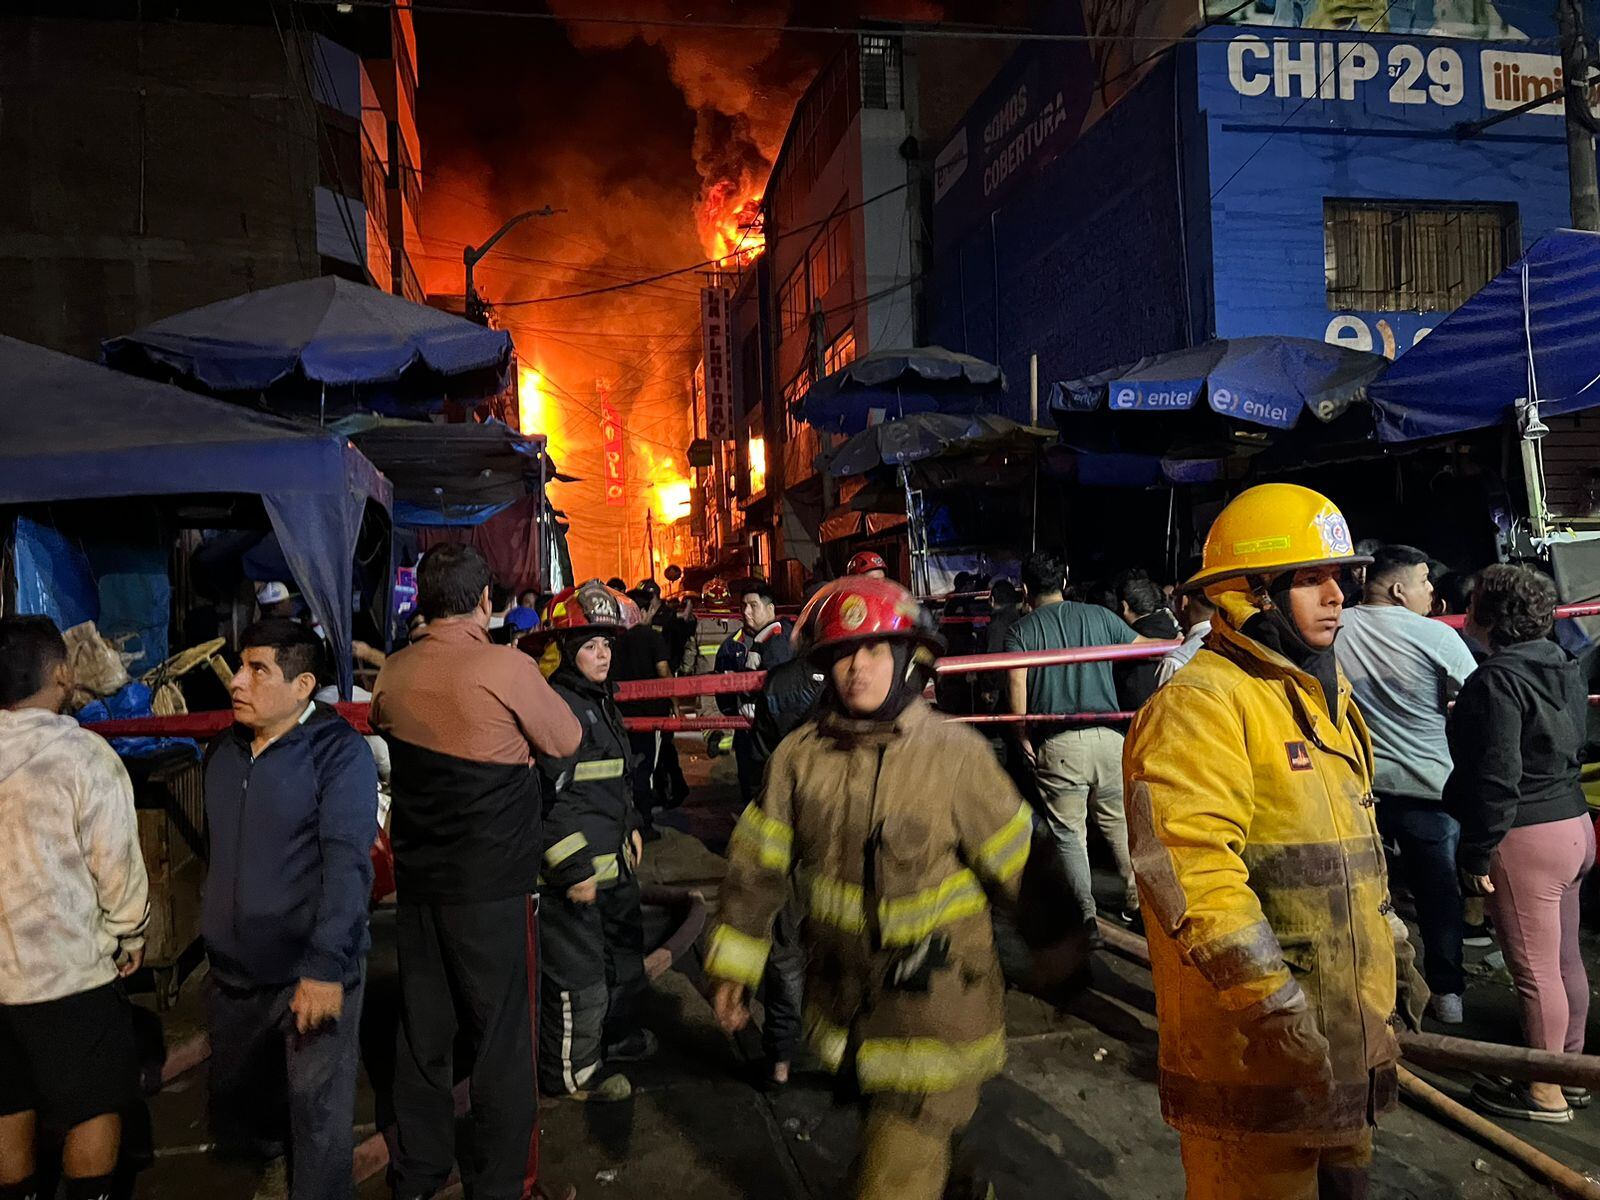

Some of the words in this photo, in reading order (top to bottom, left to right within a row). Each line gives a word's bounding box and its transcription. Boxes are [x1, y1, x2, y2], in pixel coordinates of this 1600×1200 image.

[1227, 34, 1380, 101] CHIP
[1387, 44, 1464, 106] 29
[983, 84, 1028, 144] SOMOS
[983, 91, 1067, 197] COBERTURA
[1148, 391, 1193, 406] entel
[1243, 400, 1288, 421] entel
